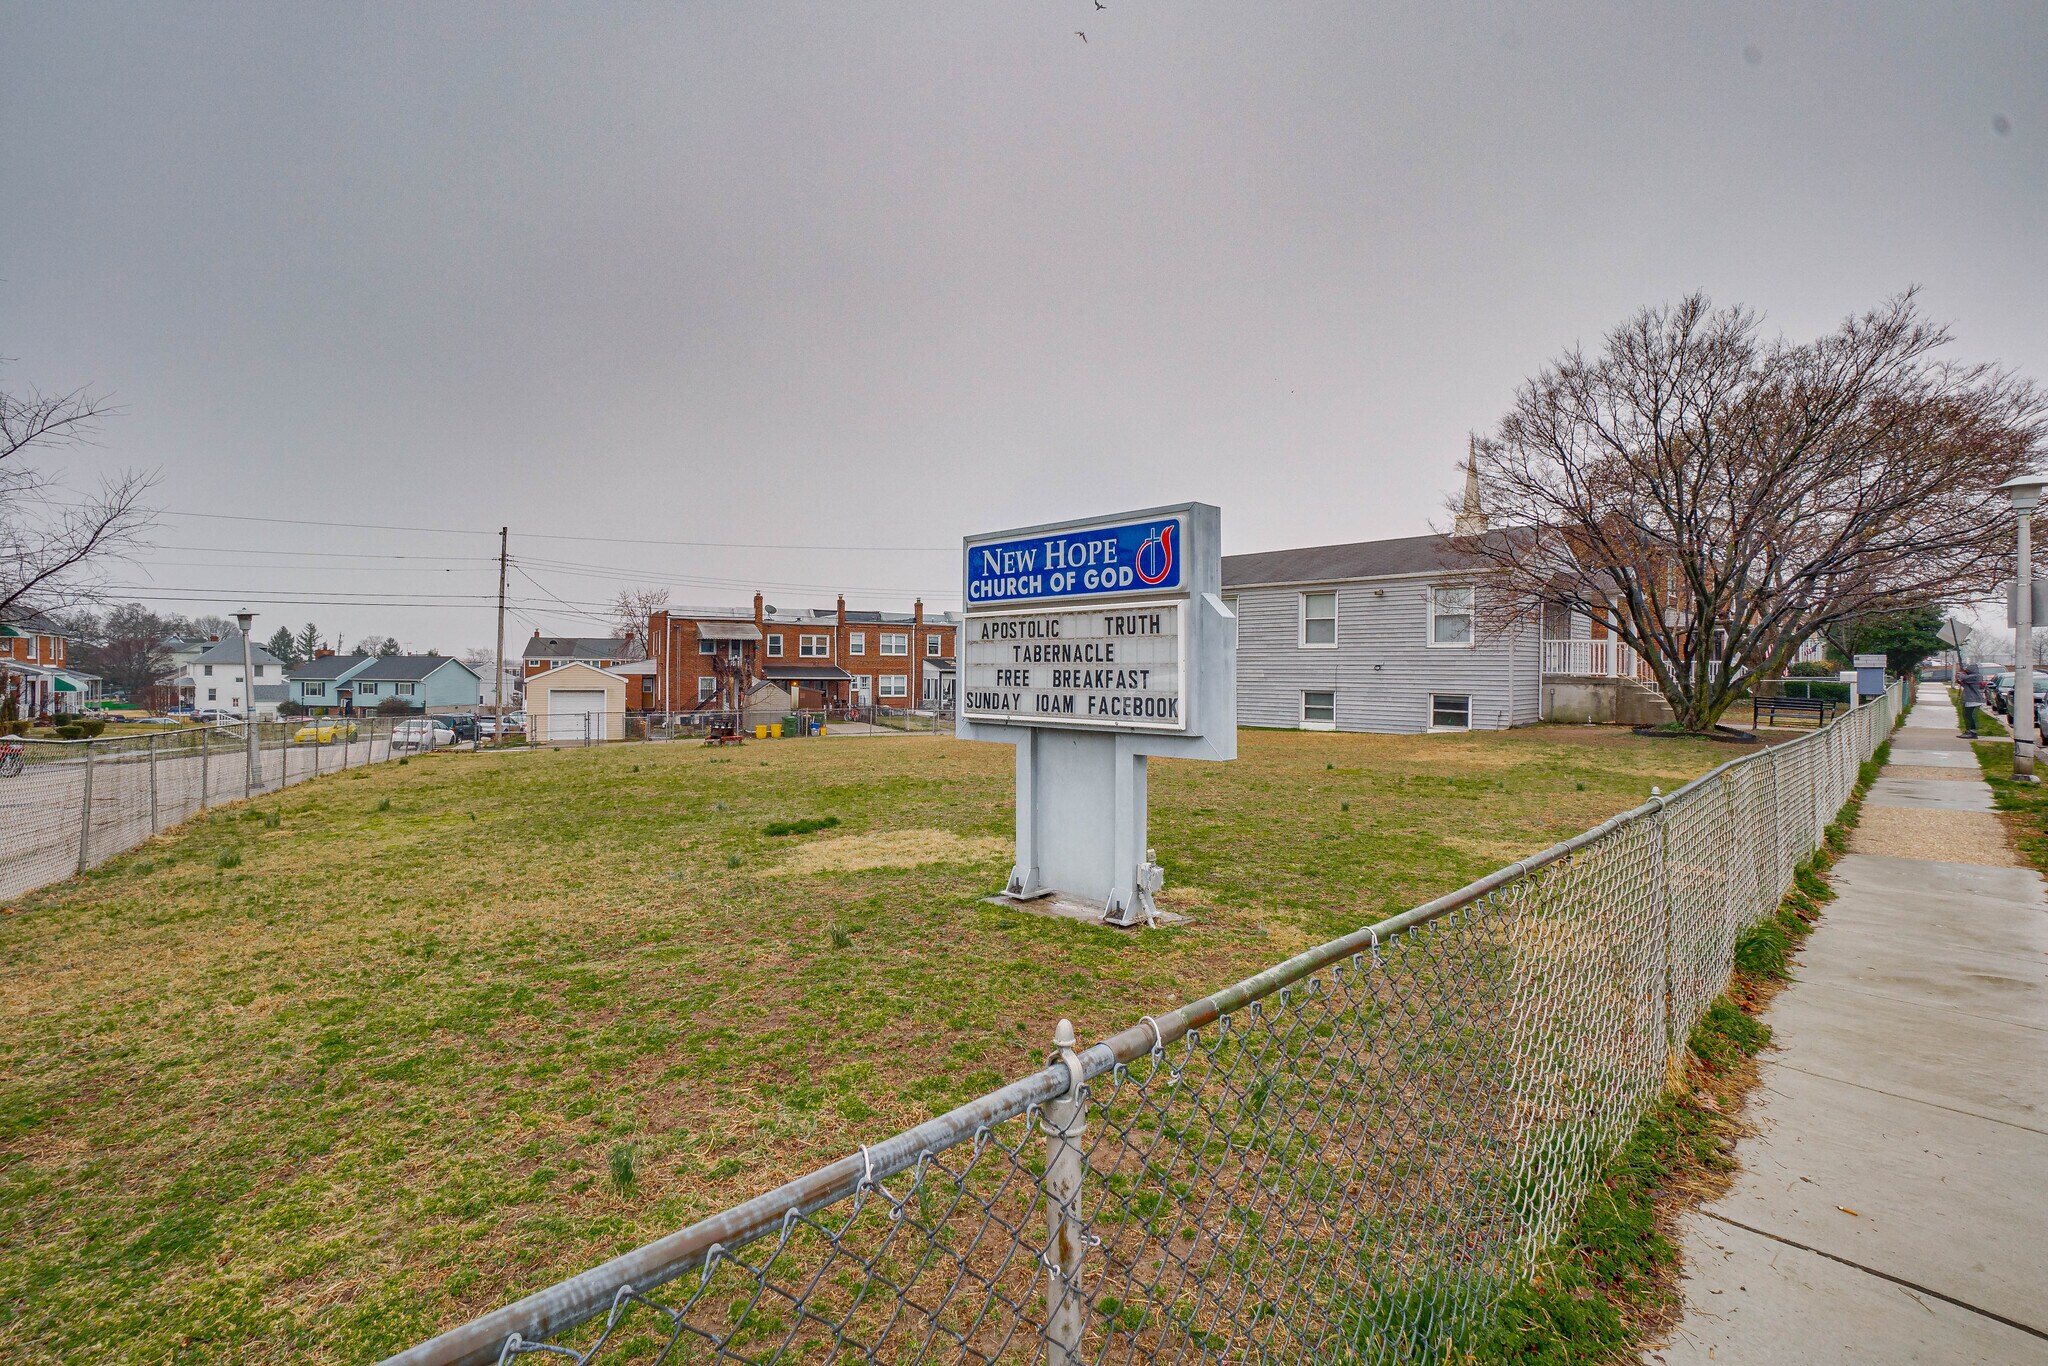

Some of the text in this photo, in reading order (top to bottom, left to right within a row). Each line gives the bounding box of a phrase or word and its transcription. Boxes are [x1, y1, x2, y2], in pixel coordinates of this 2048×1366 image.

[982, 539, 1118, 576] NEW HOPE
[970, 566, 1134, 599] CHURCH OF GOD
[981, 614, 1161, 640] APOSTOLIC TRUTH
[1013, 643, 1115, 663] TABERNACLE
[996, 669, 1150, 690] FREE BREAKFAST
[966, 692, 1021, 711] SUNDAY
[1088, 695, 1179, 718] FACEBOOK
